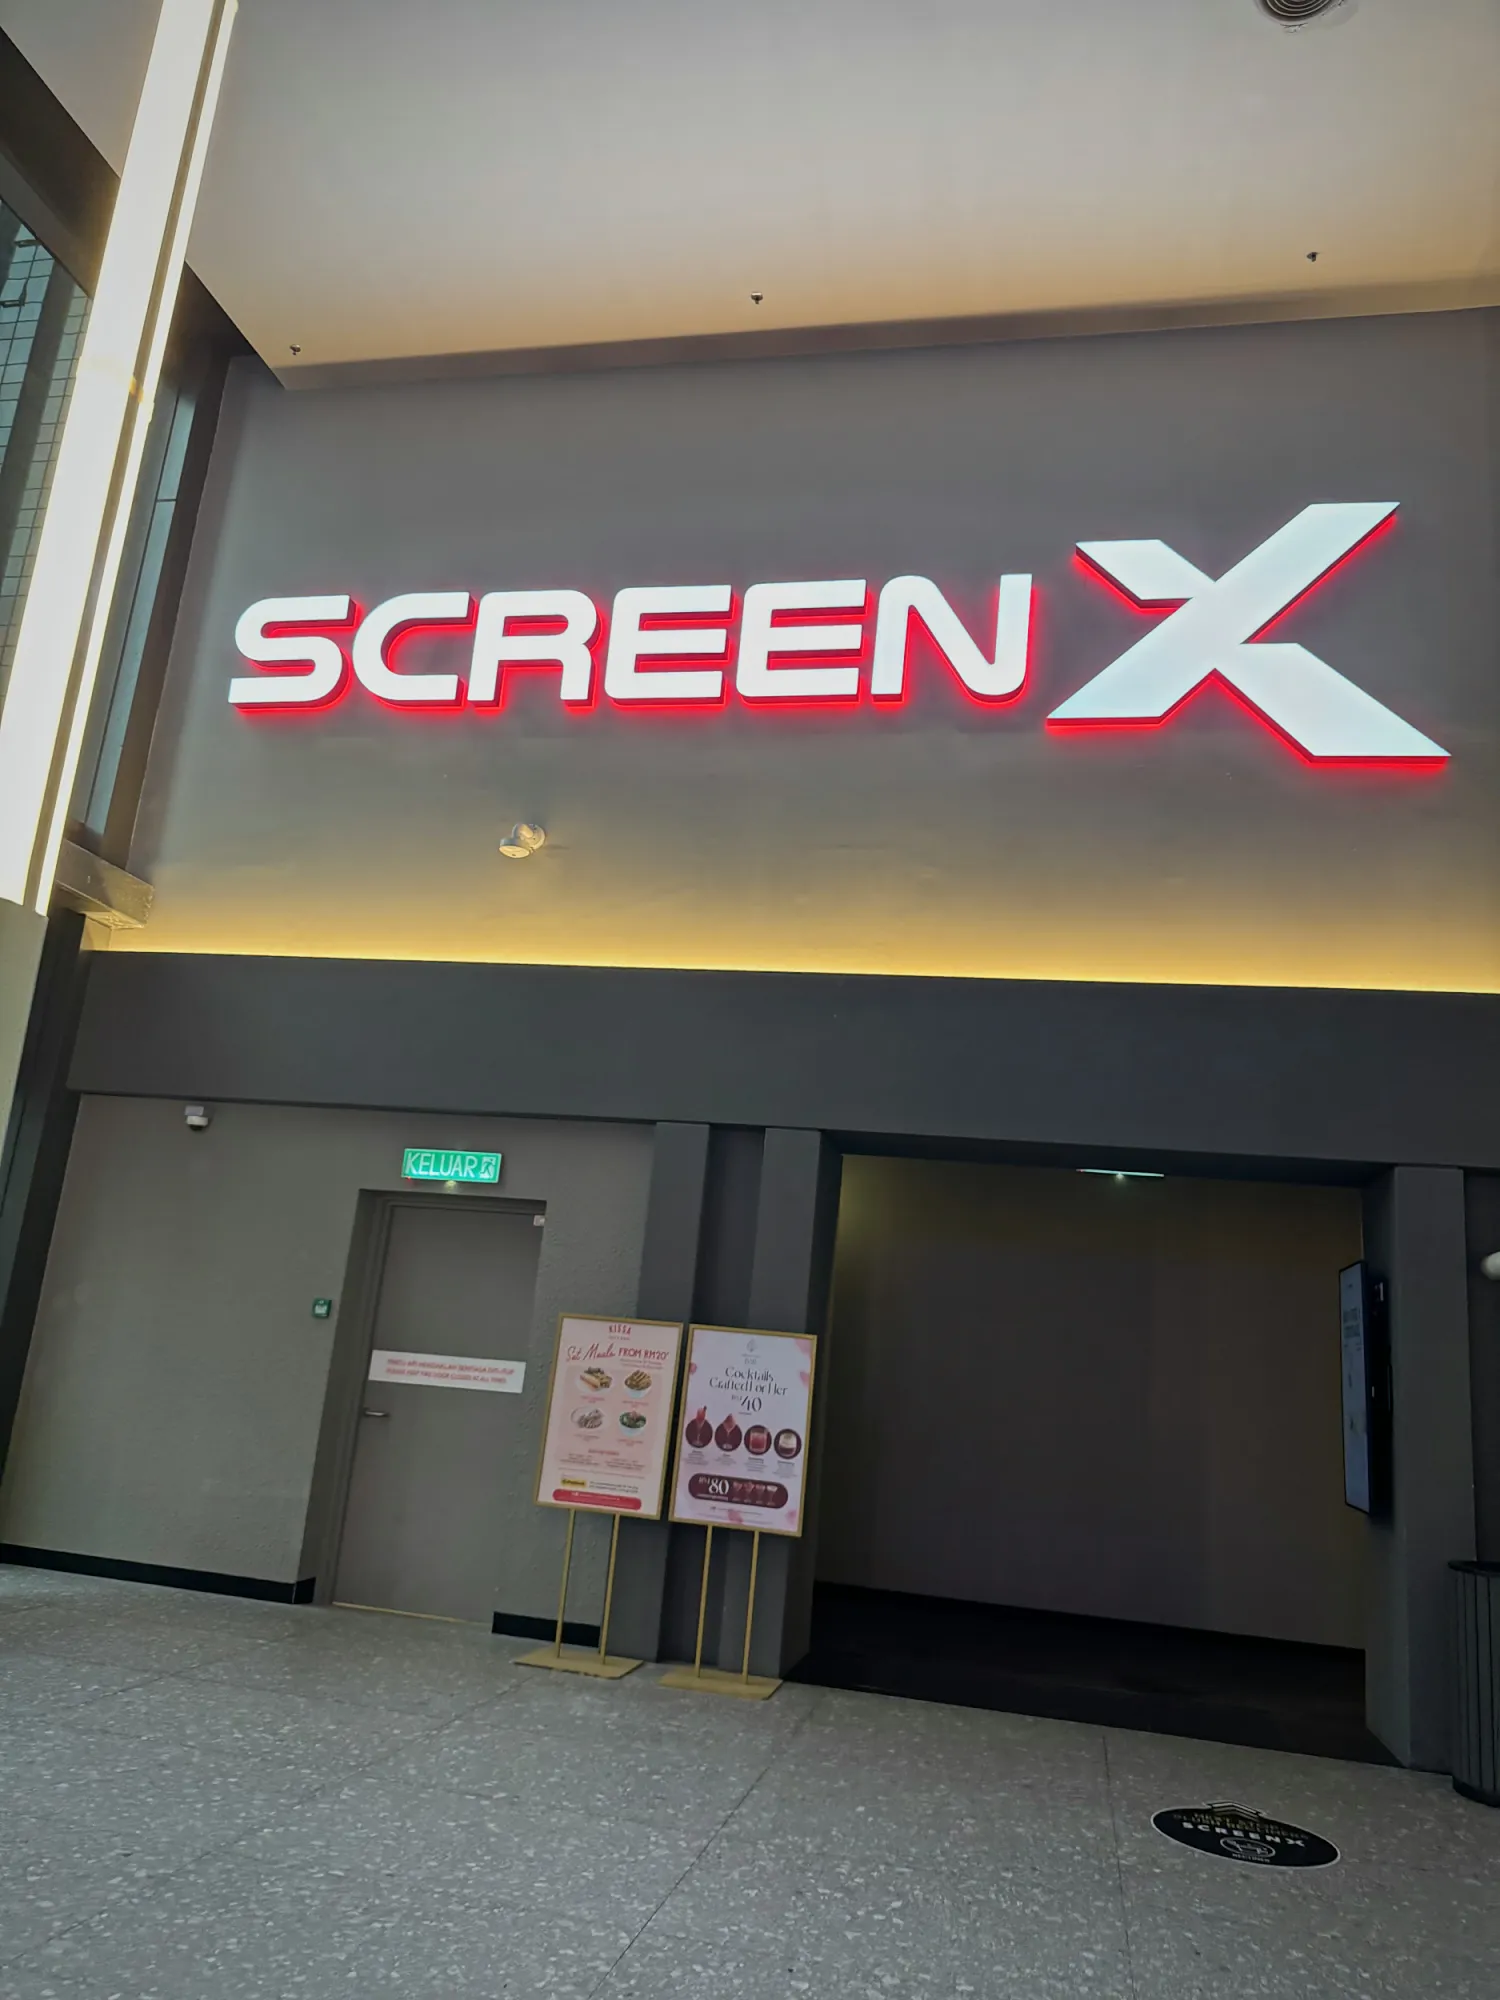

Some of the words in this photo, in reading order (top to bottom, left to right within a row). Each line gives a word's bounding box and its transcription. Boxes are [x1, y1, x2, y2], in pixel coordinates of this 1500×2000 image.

[405, 1152, 478, 1178] KELUAR
[618, 1347, 642, 1359] FROM
[725, 1366, 774, 1382] Cocktails
